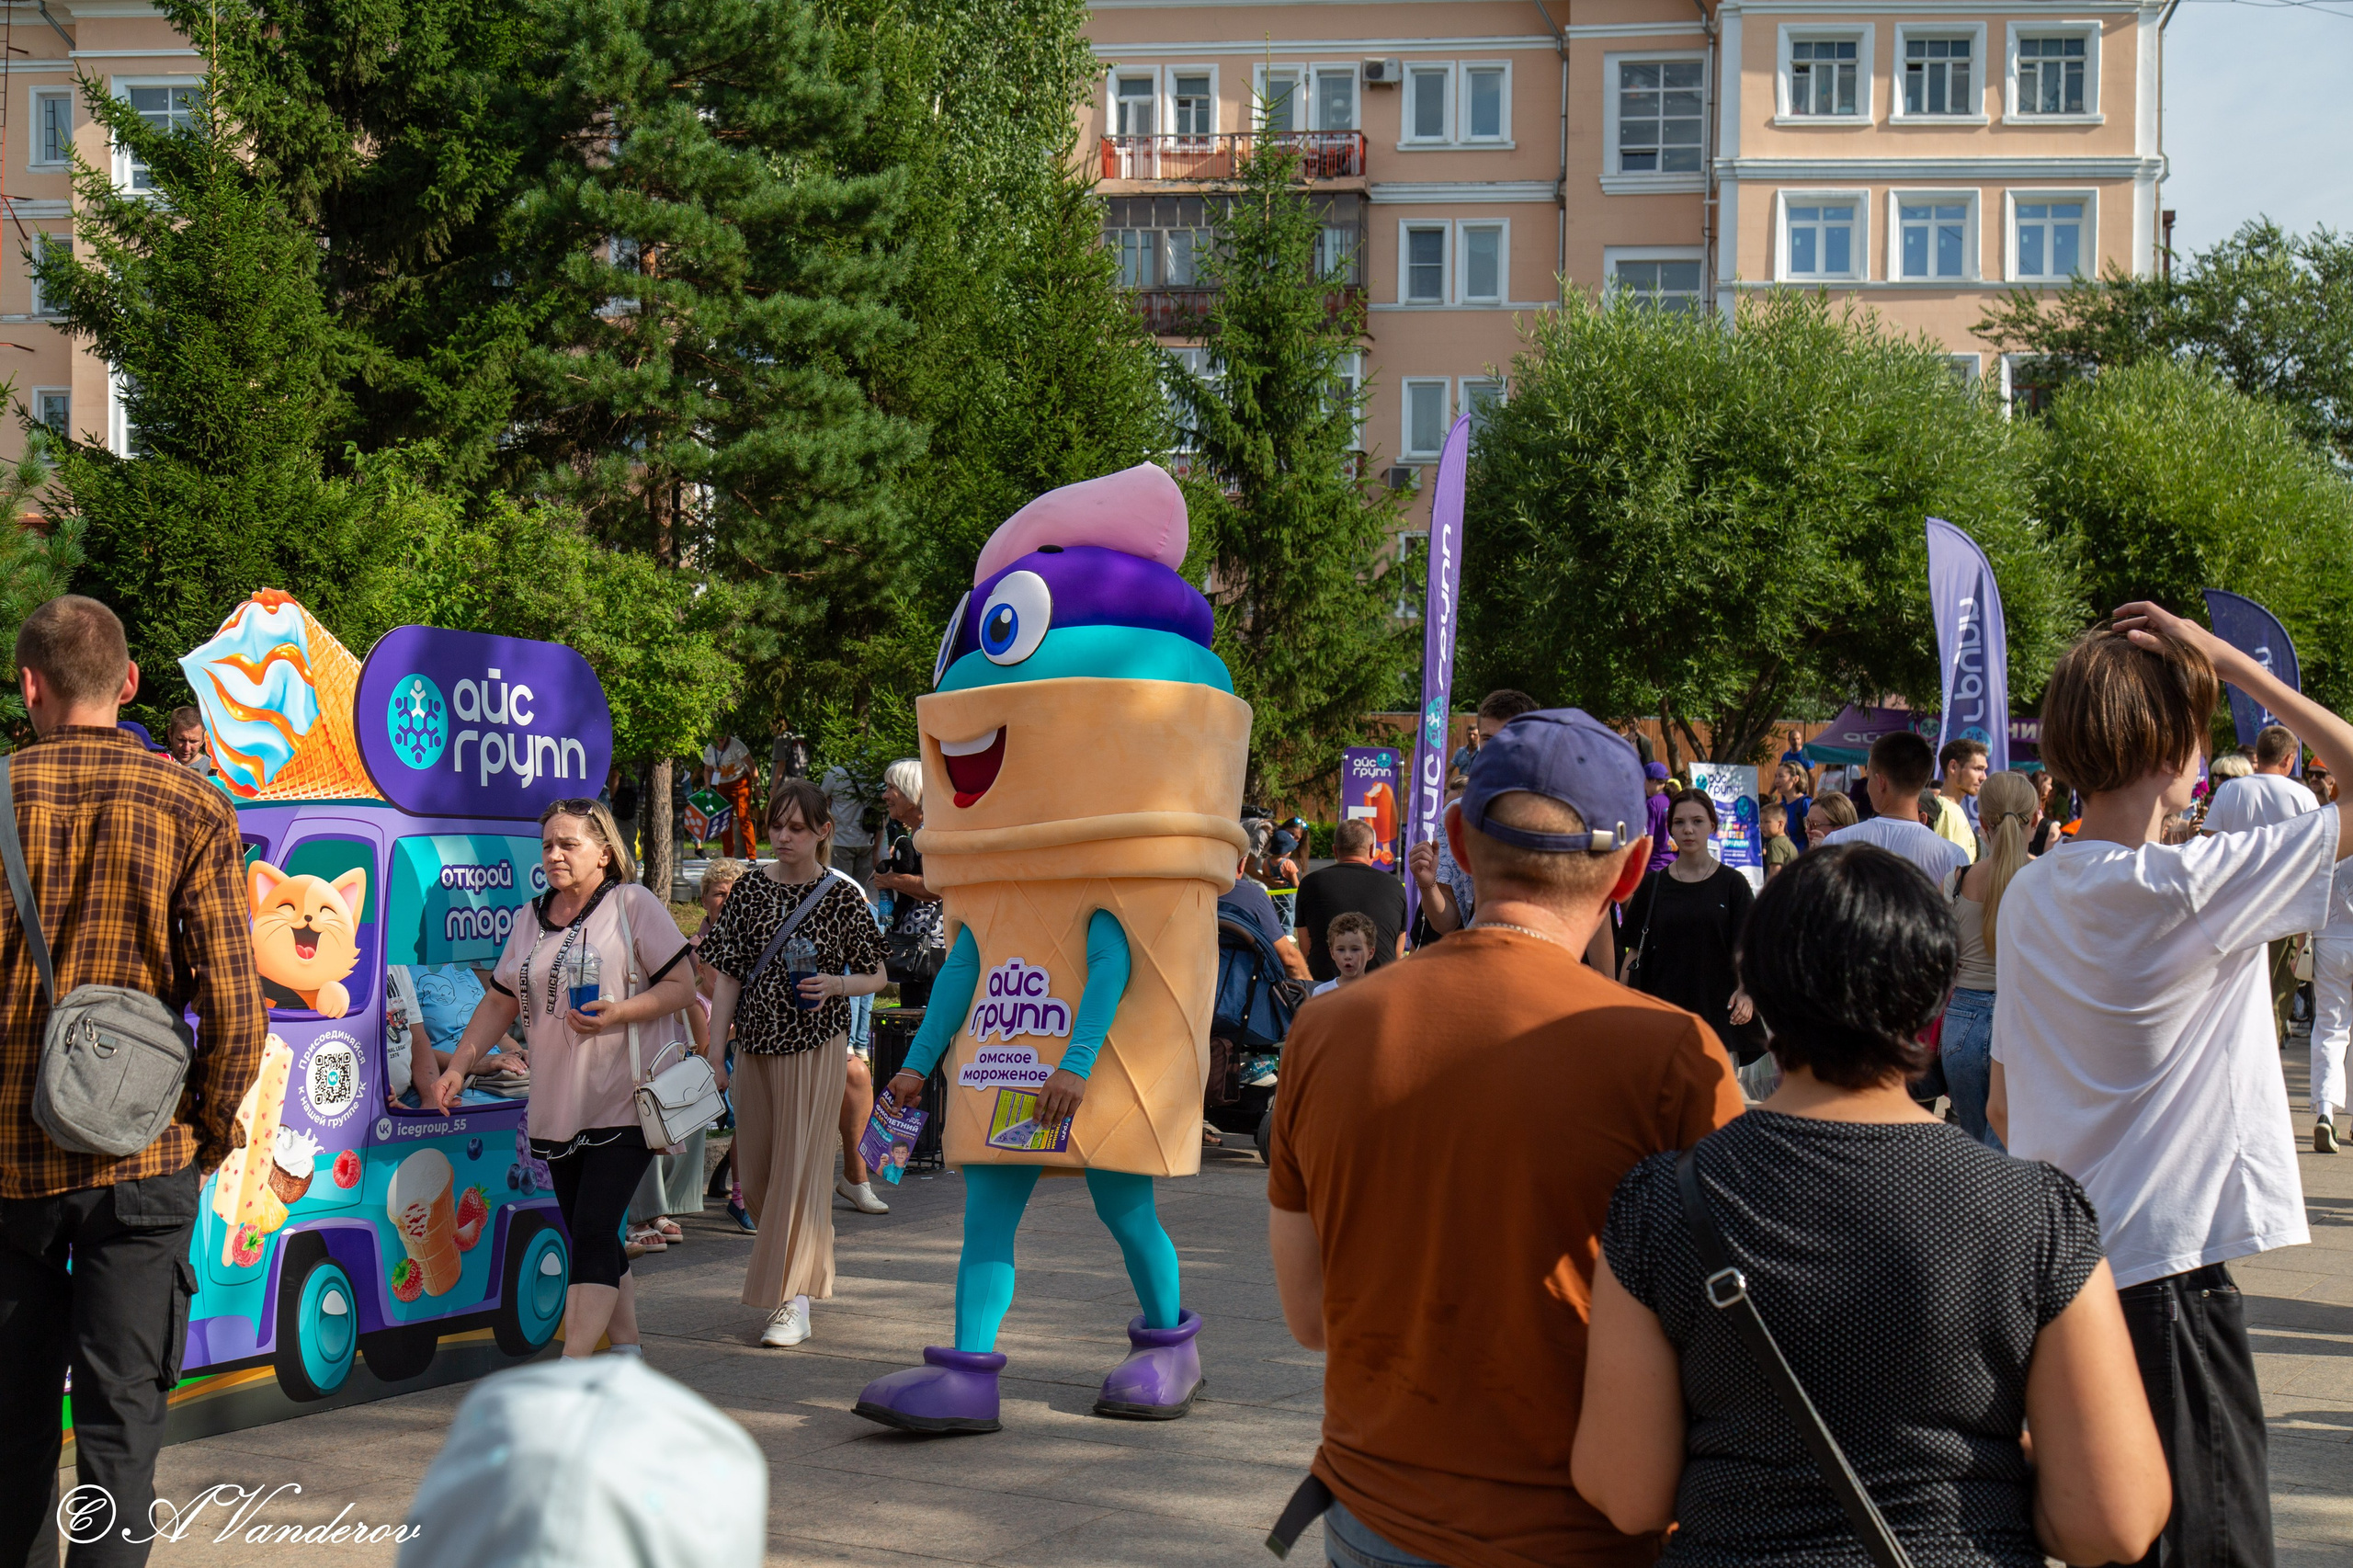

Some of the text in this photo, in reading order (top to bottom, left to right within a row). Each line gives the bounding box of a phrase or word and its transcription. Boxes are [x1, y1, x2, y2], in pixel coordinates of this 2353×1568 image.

[453, 668, 535, 727] айс
[454, 729, 586, 789] групп
[1353, 756, 1376, 767] айс
[1353, 767, 1392, 778] групп
[441, 862, 512, 892] открой
[989, 964, 1044, 997] айс
[971, 1002, 1066, 1036] групп
[298, 1030, 366, 1070] Присоединяйся
[979, 1051, 1032, 1064] омское
[963, 1067, 1049, 1083] мороженое
[301, 1096, 326, 1126] нашей
[327, 1101, 359, 1129] группе
[356, 1081, 367, 1098] VK
[397, 1119, 467, 1138] icegroup_55
